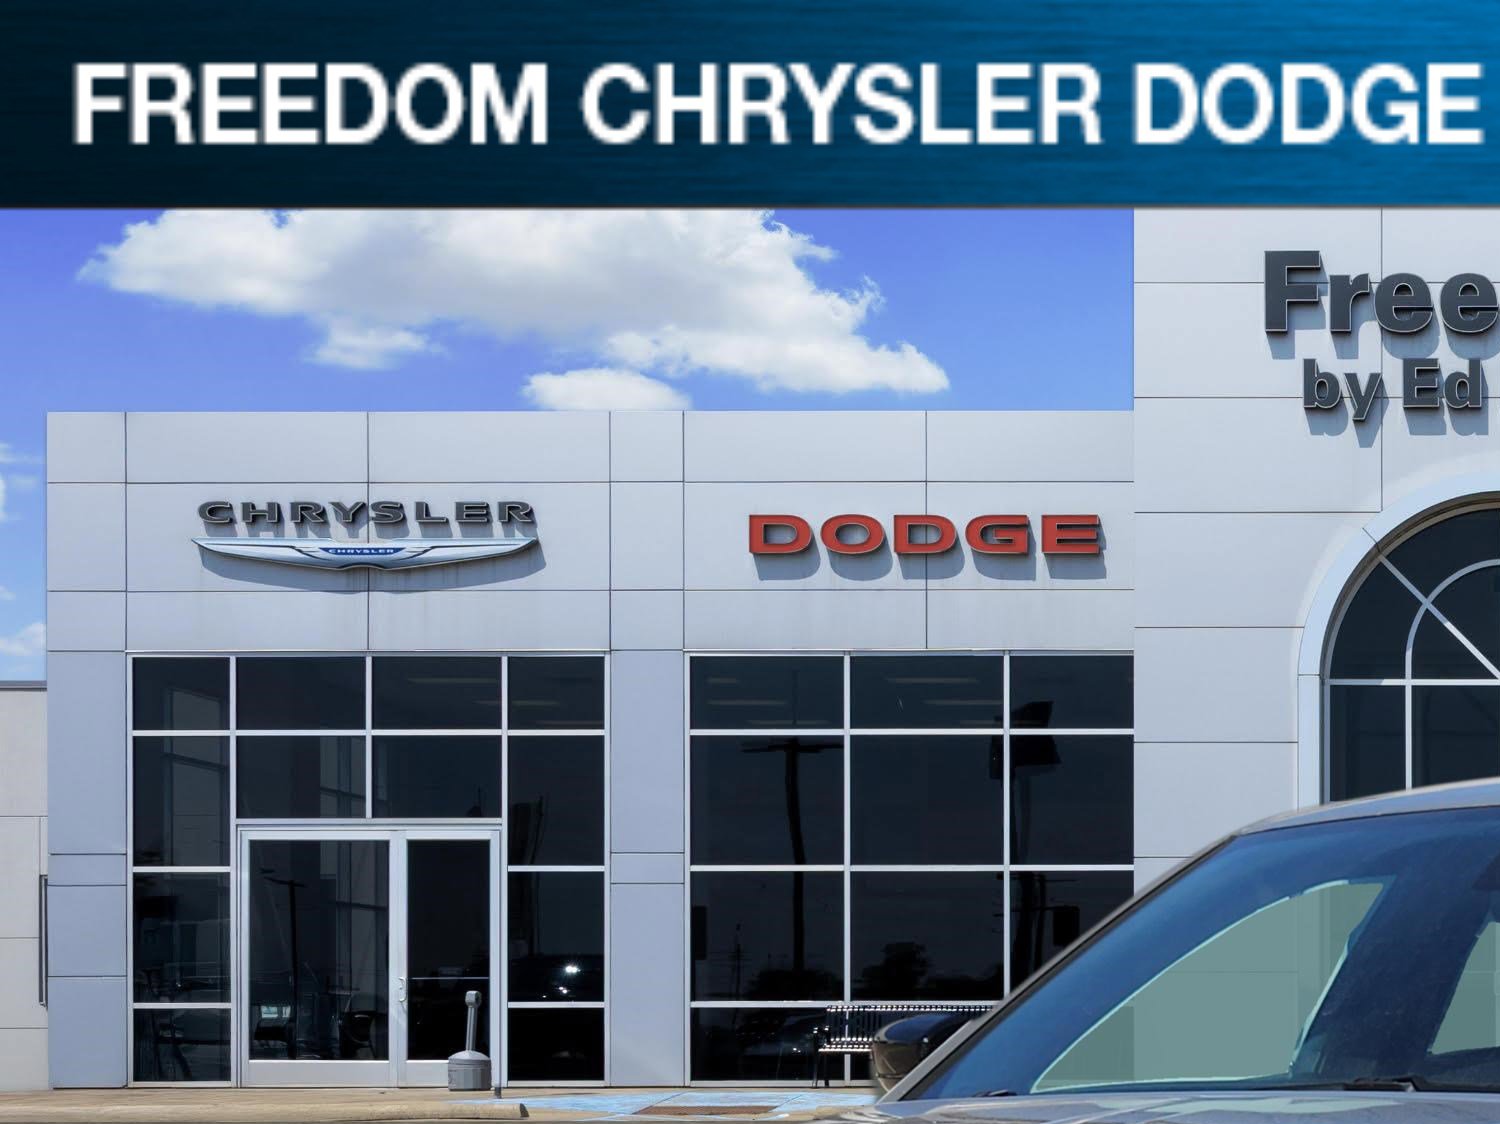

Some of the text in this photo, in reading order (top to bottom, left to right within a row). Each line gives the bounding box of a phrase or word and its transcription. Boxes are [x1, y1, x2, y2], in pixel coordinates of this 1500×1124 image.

[1303, 358, 1382, 422] by
[1402, 358, 1482, 408] Ed
[198, 500, 536, 524] CHRYSLER
[749, 513, 1101, 554] DODGE
